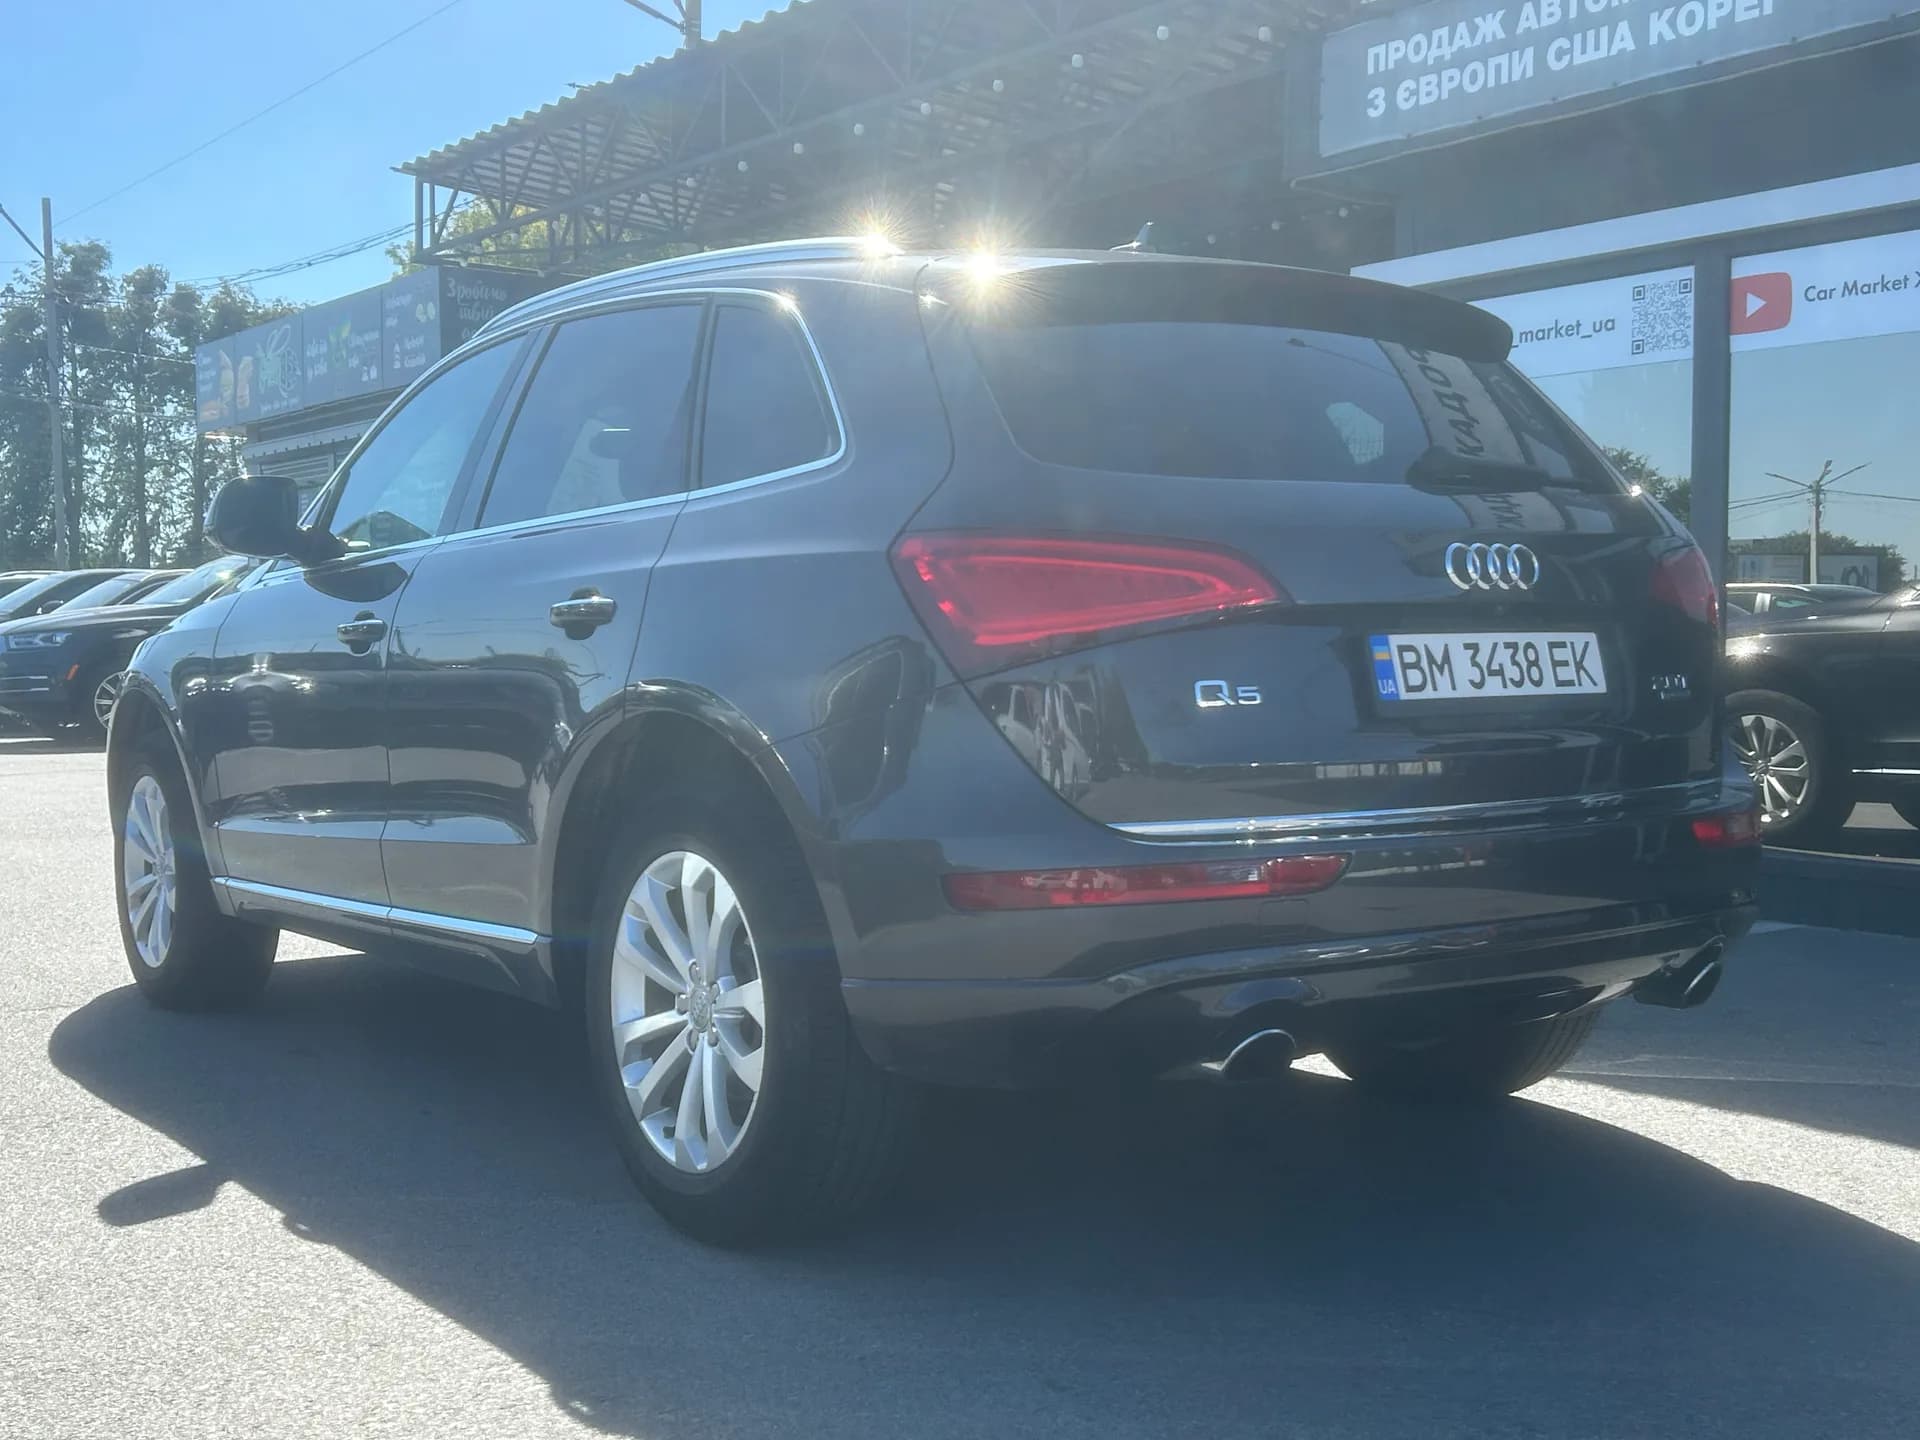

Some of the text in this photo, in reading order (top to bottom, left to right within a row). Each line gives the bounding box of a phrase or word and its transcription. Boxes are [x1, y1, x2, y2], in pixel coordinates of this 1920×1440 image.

[1367, 0, 1633, 76] ПРОДАЖ АВТО
[1396, 46, 1535, 111] ЄВРОПИ
[1547, 19, 1636, 71] США
[1804, 285, 1836, 302] Car
[1841, 273, 1909, 298] Market
[1378, 679, 1397, 694] UA
[1397, 643, 1457, 694] BM
[1462, 641, 1544, 690] 3438
[1547, 640, 1599, 688] EK
[1194, 679, 1263, 707] Q5
